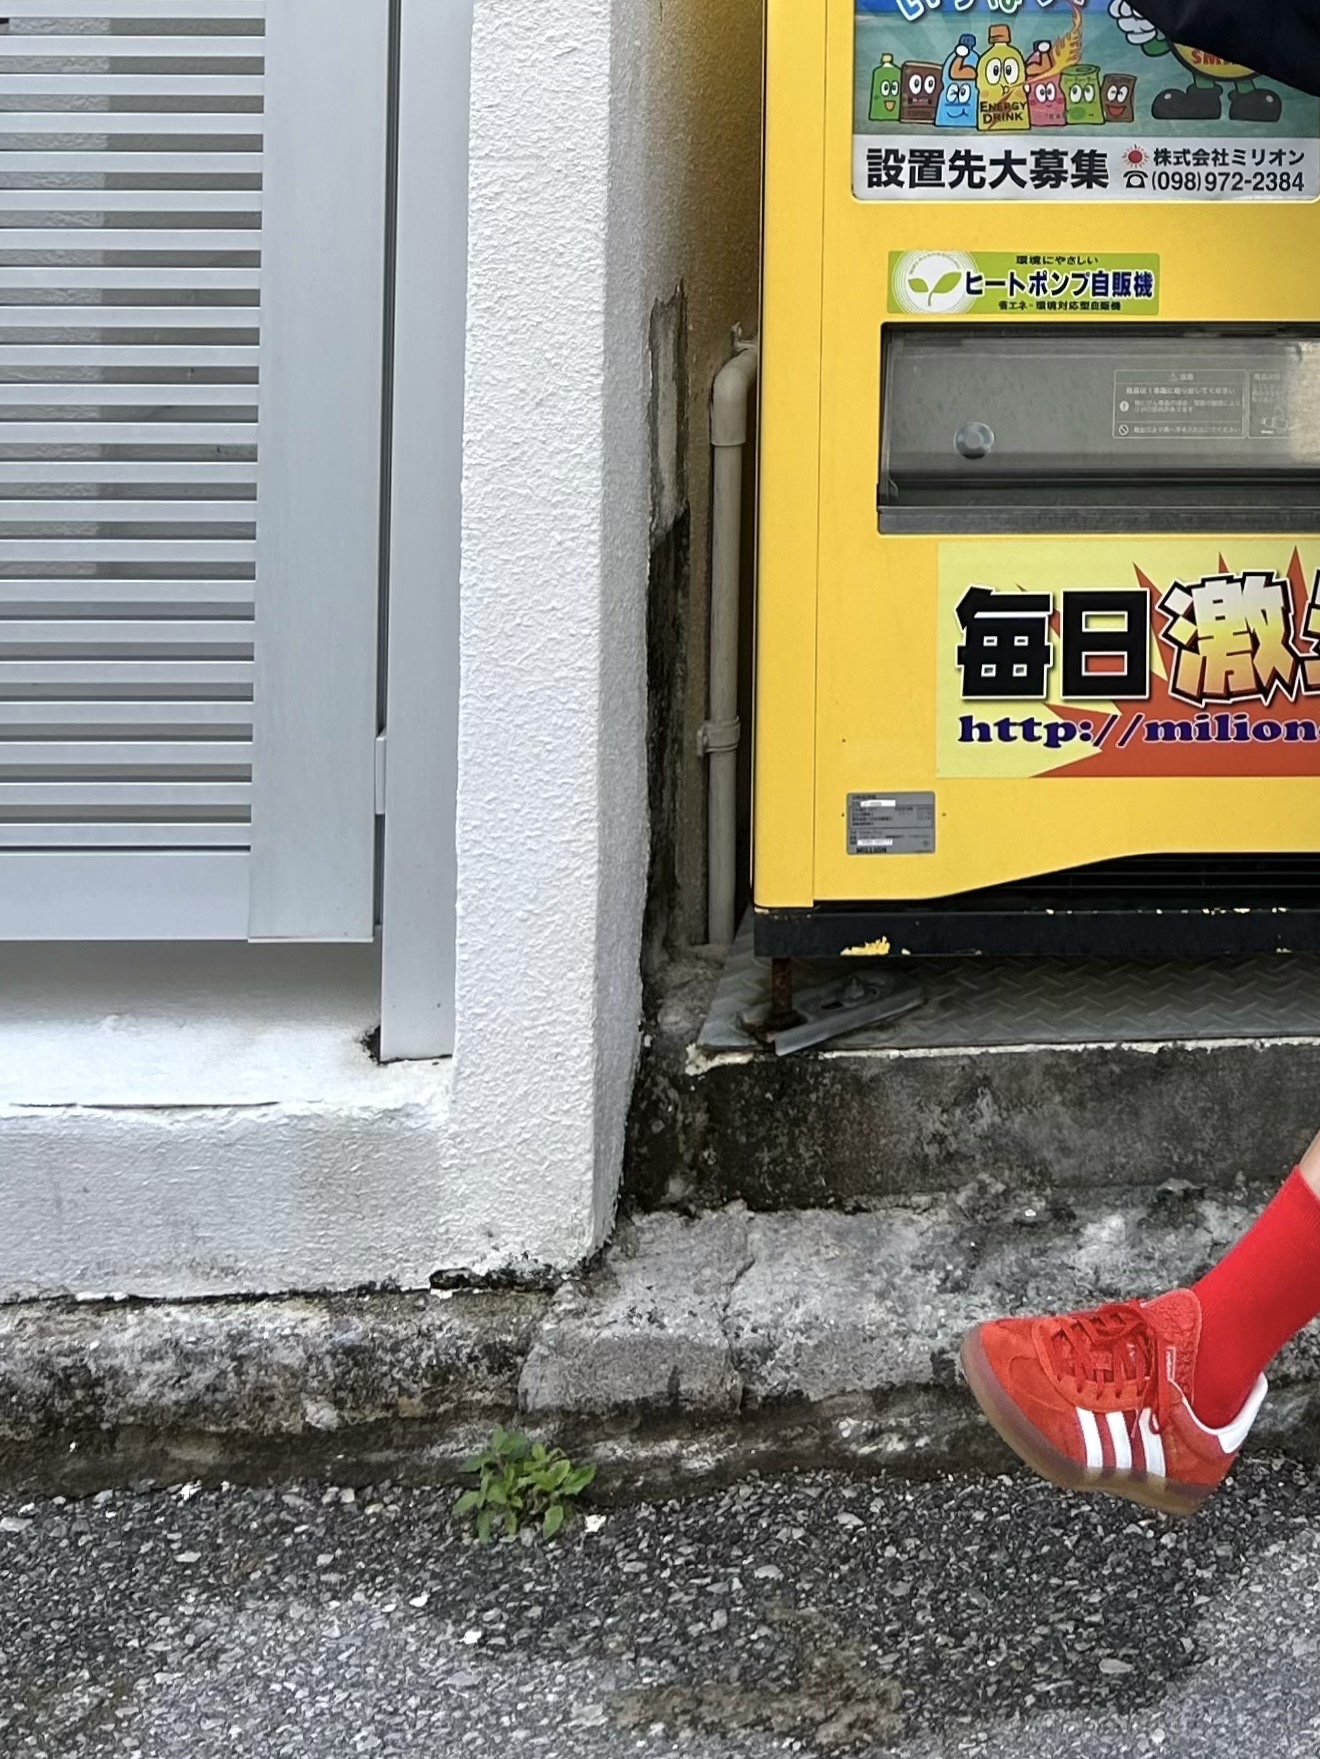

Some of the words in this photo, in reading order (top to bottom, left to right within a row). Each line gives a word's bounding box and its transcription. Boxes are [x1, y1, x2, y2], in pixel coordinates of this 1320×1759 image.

[979, 101, 1028, 113] ENERGY
[983, 111, 1024, 124] DRINK
[866, 148, 1109, 190] 設置先大募集
[1152, 147, 1306, 170] 株式会社ミリオン
[1151, 171, 1305, 193] (098)972-2384
[1015, 255, 1099, 266] 環境にやさしい
[965, 269, 1156, 299] ヒートポンプ自販機
